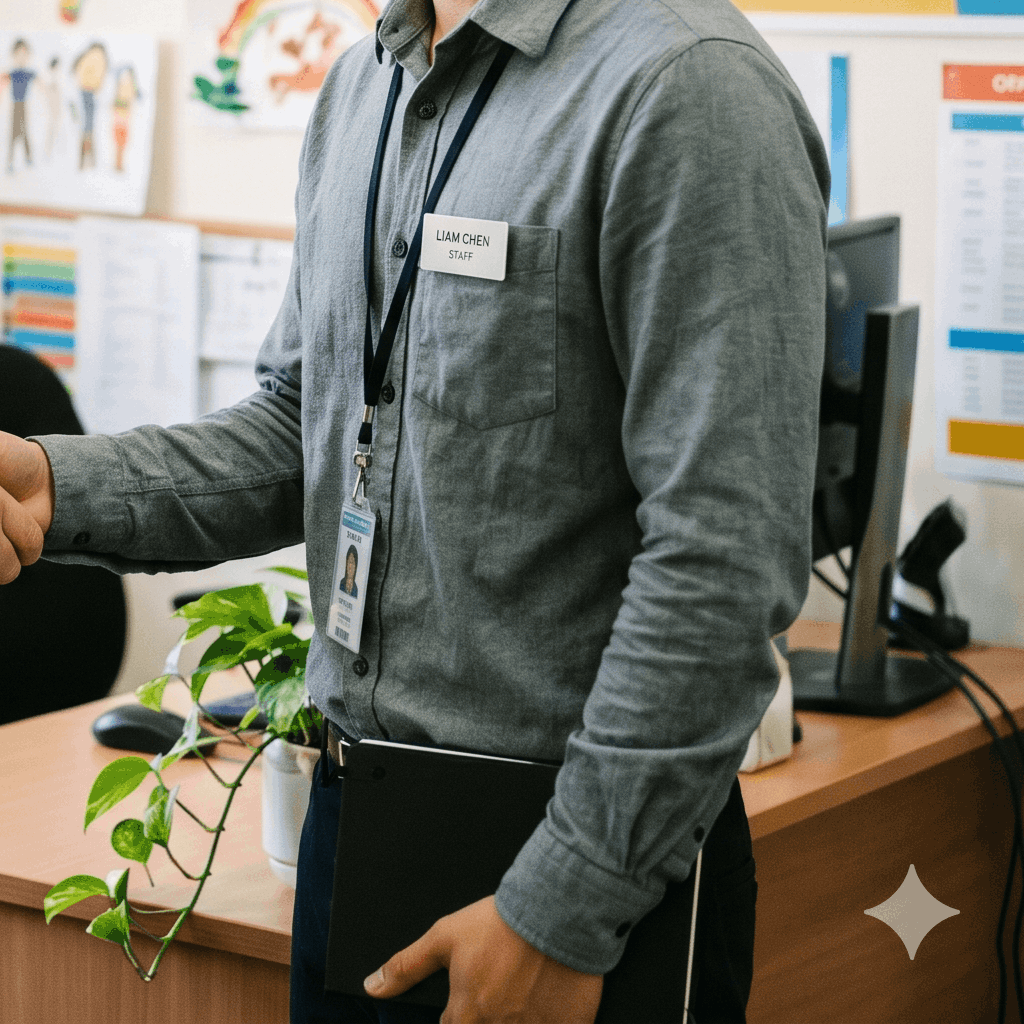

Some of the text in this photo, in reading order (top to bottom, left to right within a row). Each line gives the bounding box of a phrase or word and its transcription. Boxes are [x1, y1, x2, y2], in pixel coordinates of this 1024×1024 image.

[436, 229, 490, 247] LIAM CHEN
[448, 249, 474, 261] STAFF
